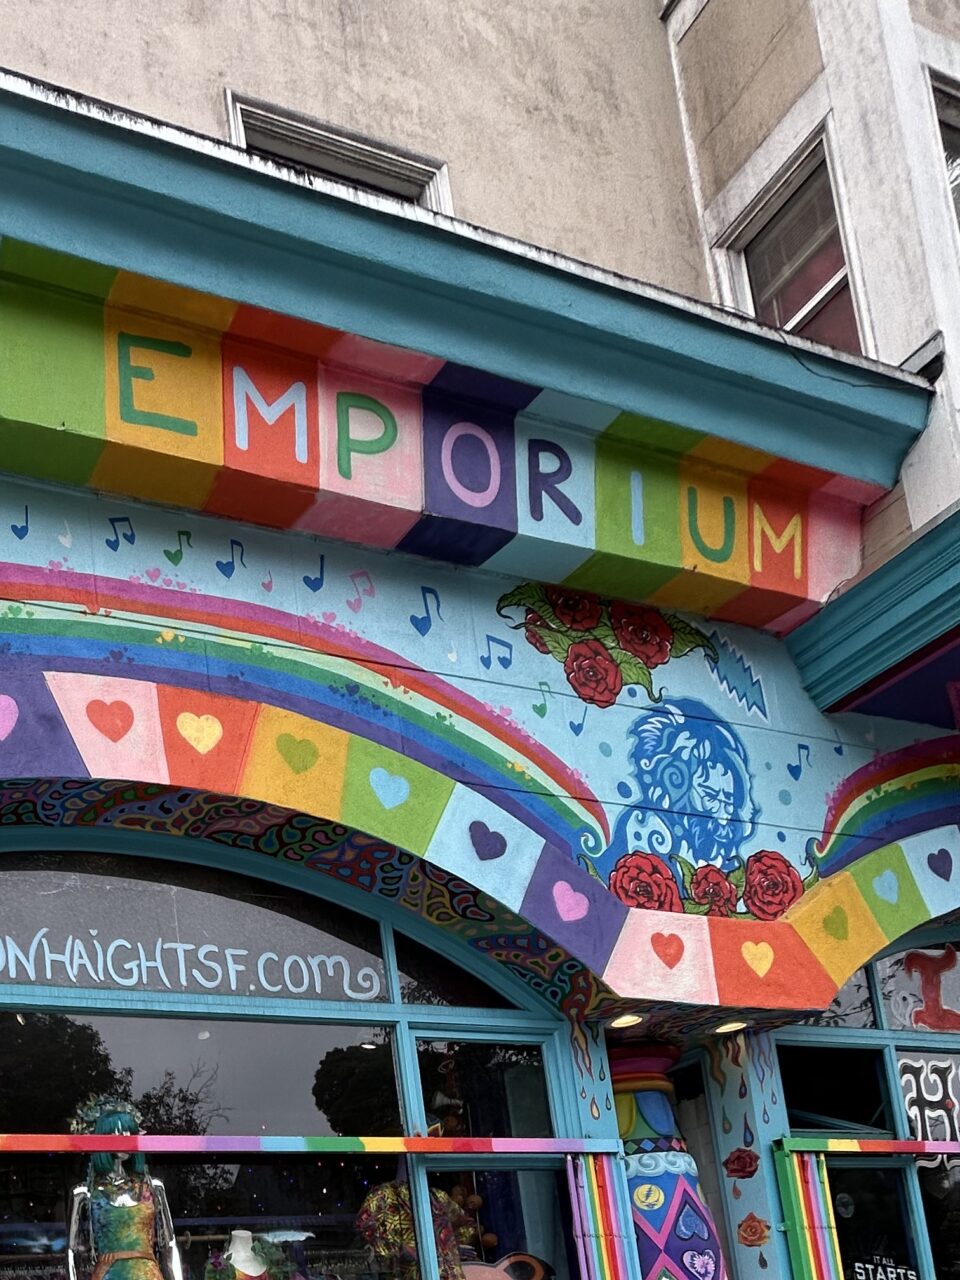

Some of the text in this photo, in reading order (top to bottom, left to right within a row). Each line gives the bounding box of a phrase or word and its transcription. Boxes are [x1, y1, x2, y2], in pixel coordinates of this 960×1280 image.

[118, 330, 805, 580] EMPORIUM
[873, 1255, 895, 1267] IT ALL
